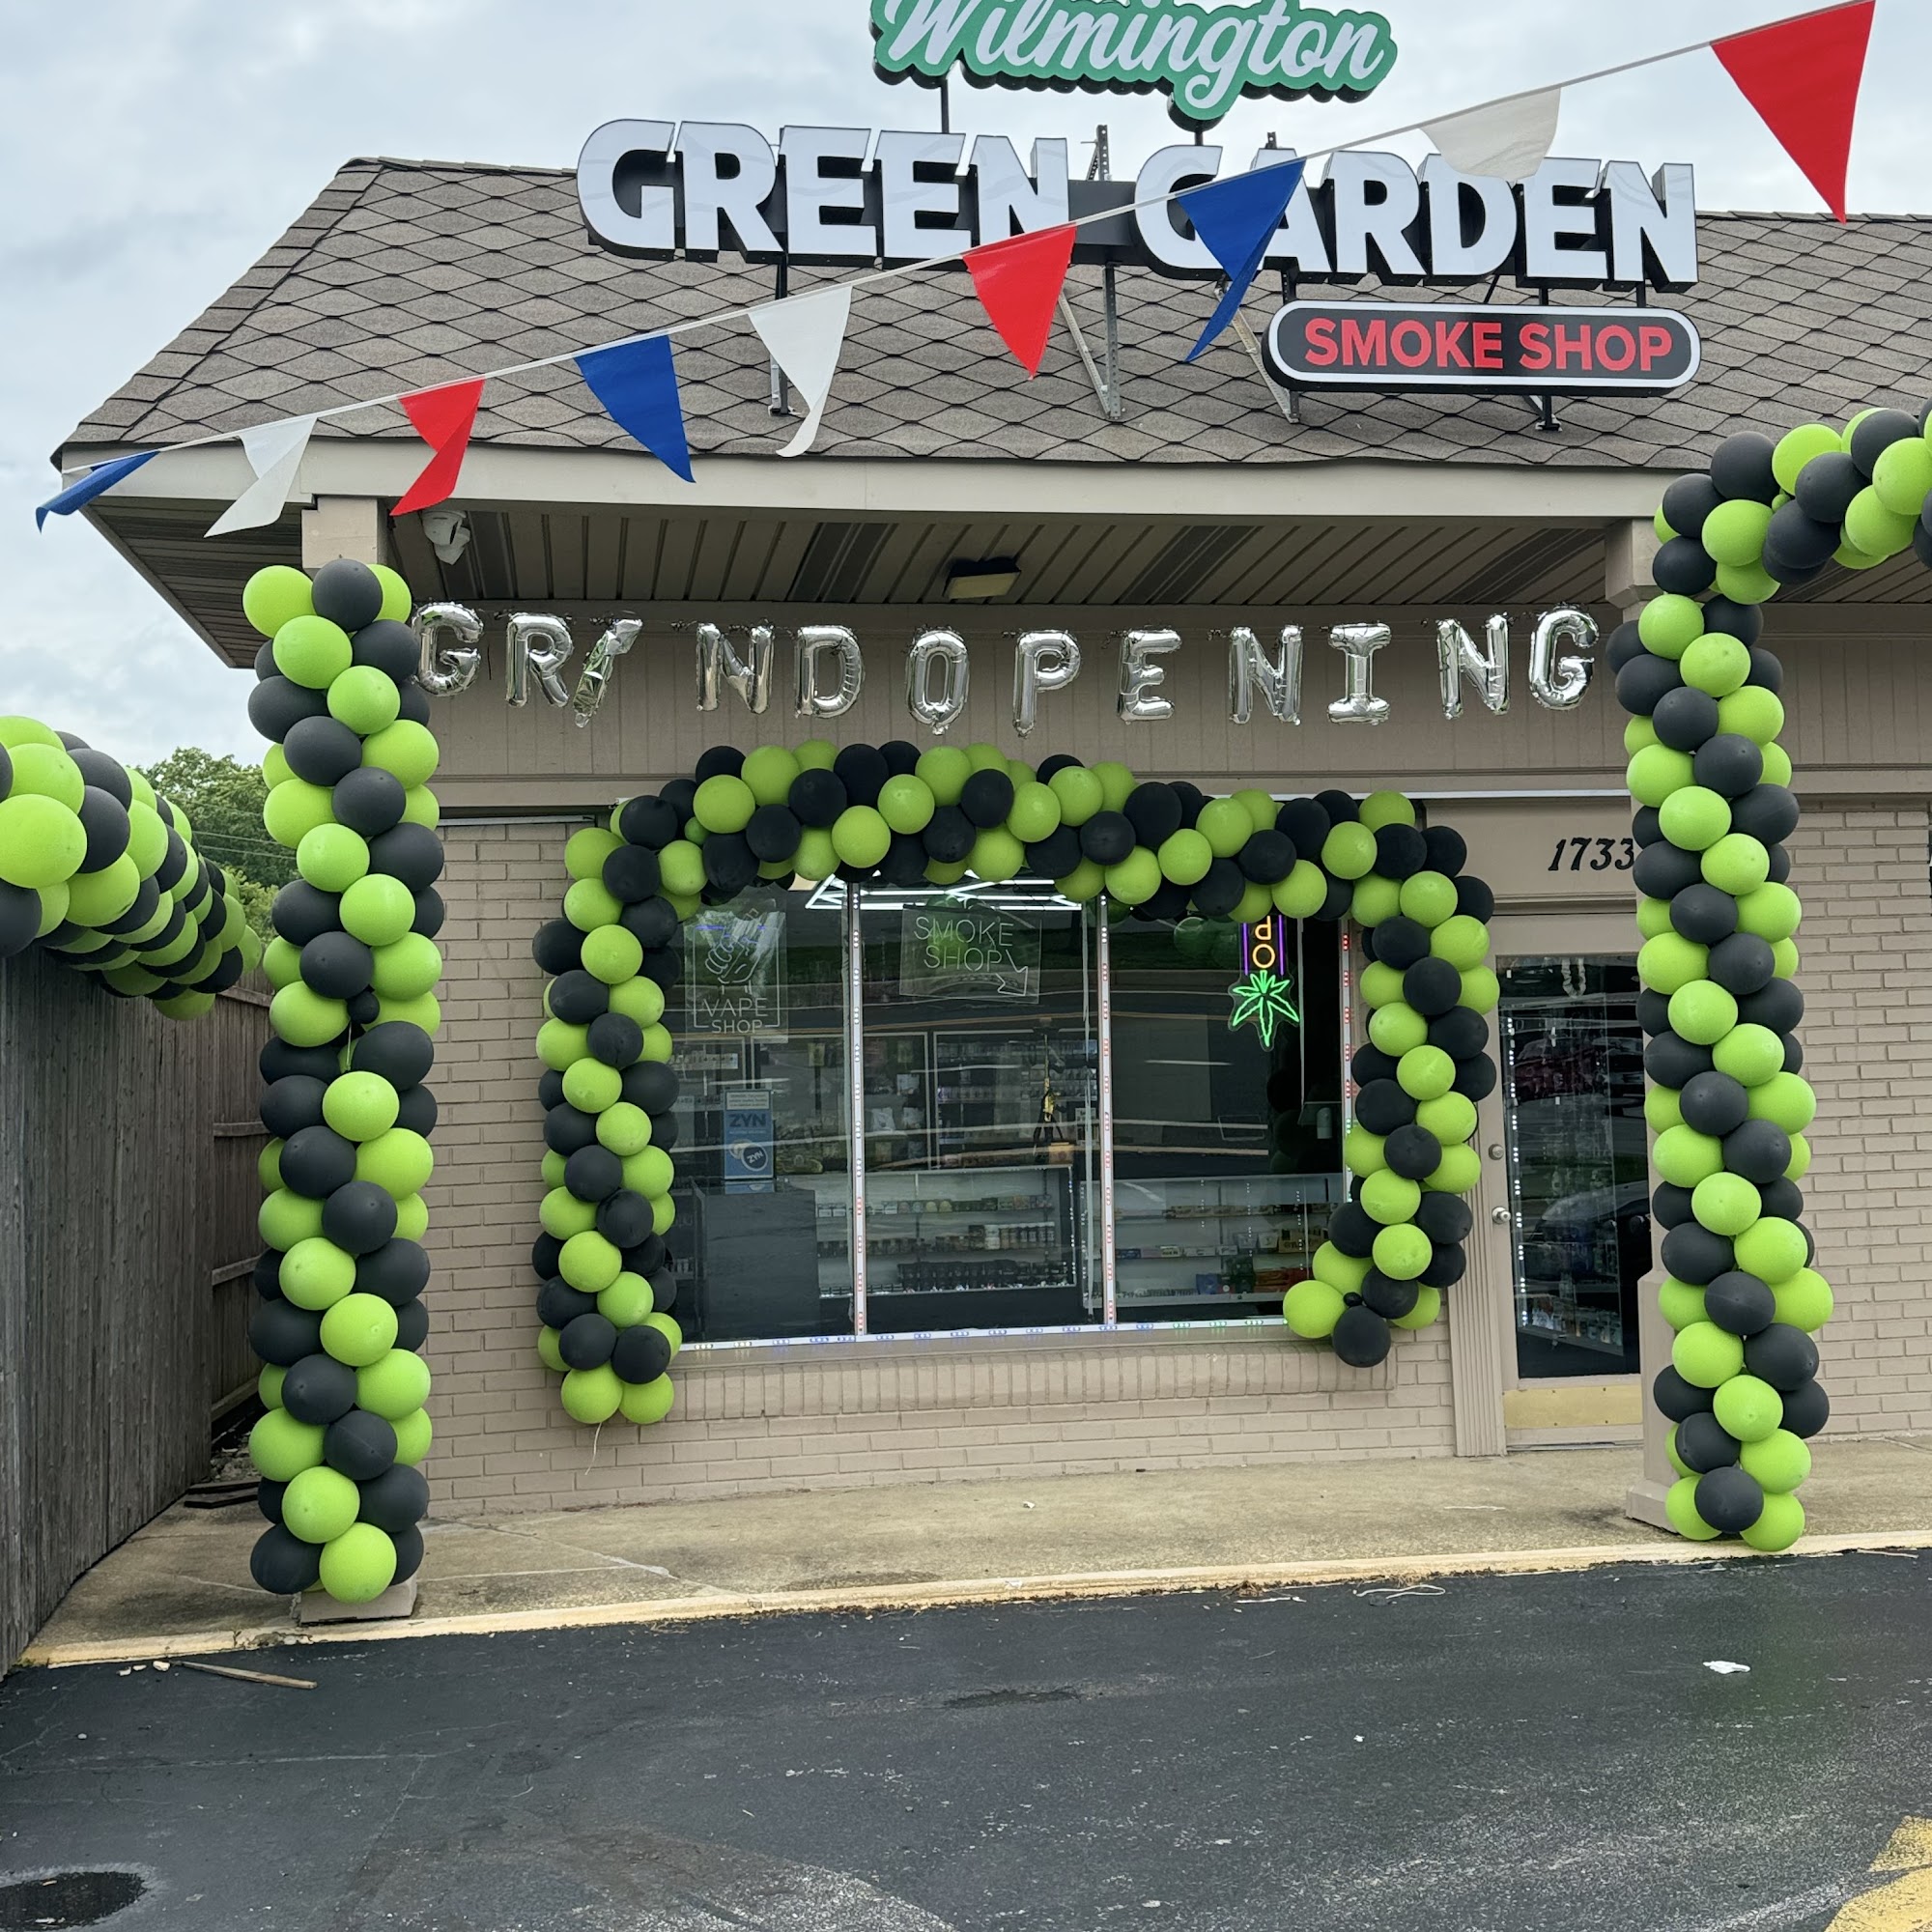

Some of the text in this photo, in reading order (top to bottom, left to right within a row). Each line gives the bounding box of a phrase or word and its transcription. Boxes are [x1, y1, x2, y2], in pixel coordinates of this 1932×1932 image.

[883, 0, 1384, 108] Wilmington
[577, 119, 1698, 285] GREEN GARDEN
[1304, 317, 1672, 372] SMOKE SHOP
[905, 603, 1600, 736] OPENING
[1548, 837, 1634, 871] 1733
[914, 917, 1014, 947] SMOKE
[923, 945, 1003, 973] SHOP
[703, 997, 769, 1017] VAPE
[711, 1019, 763, 1034] SHOP
[729, 1113, 767, 1128] ZYN
[746, 1150, 764, 1164] ZYN
